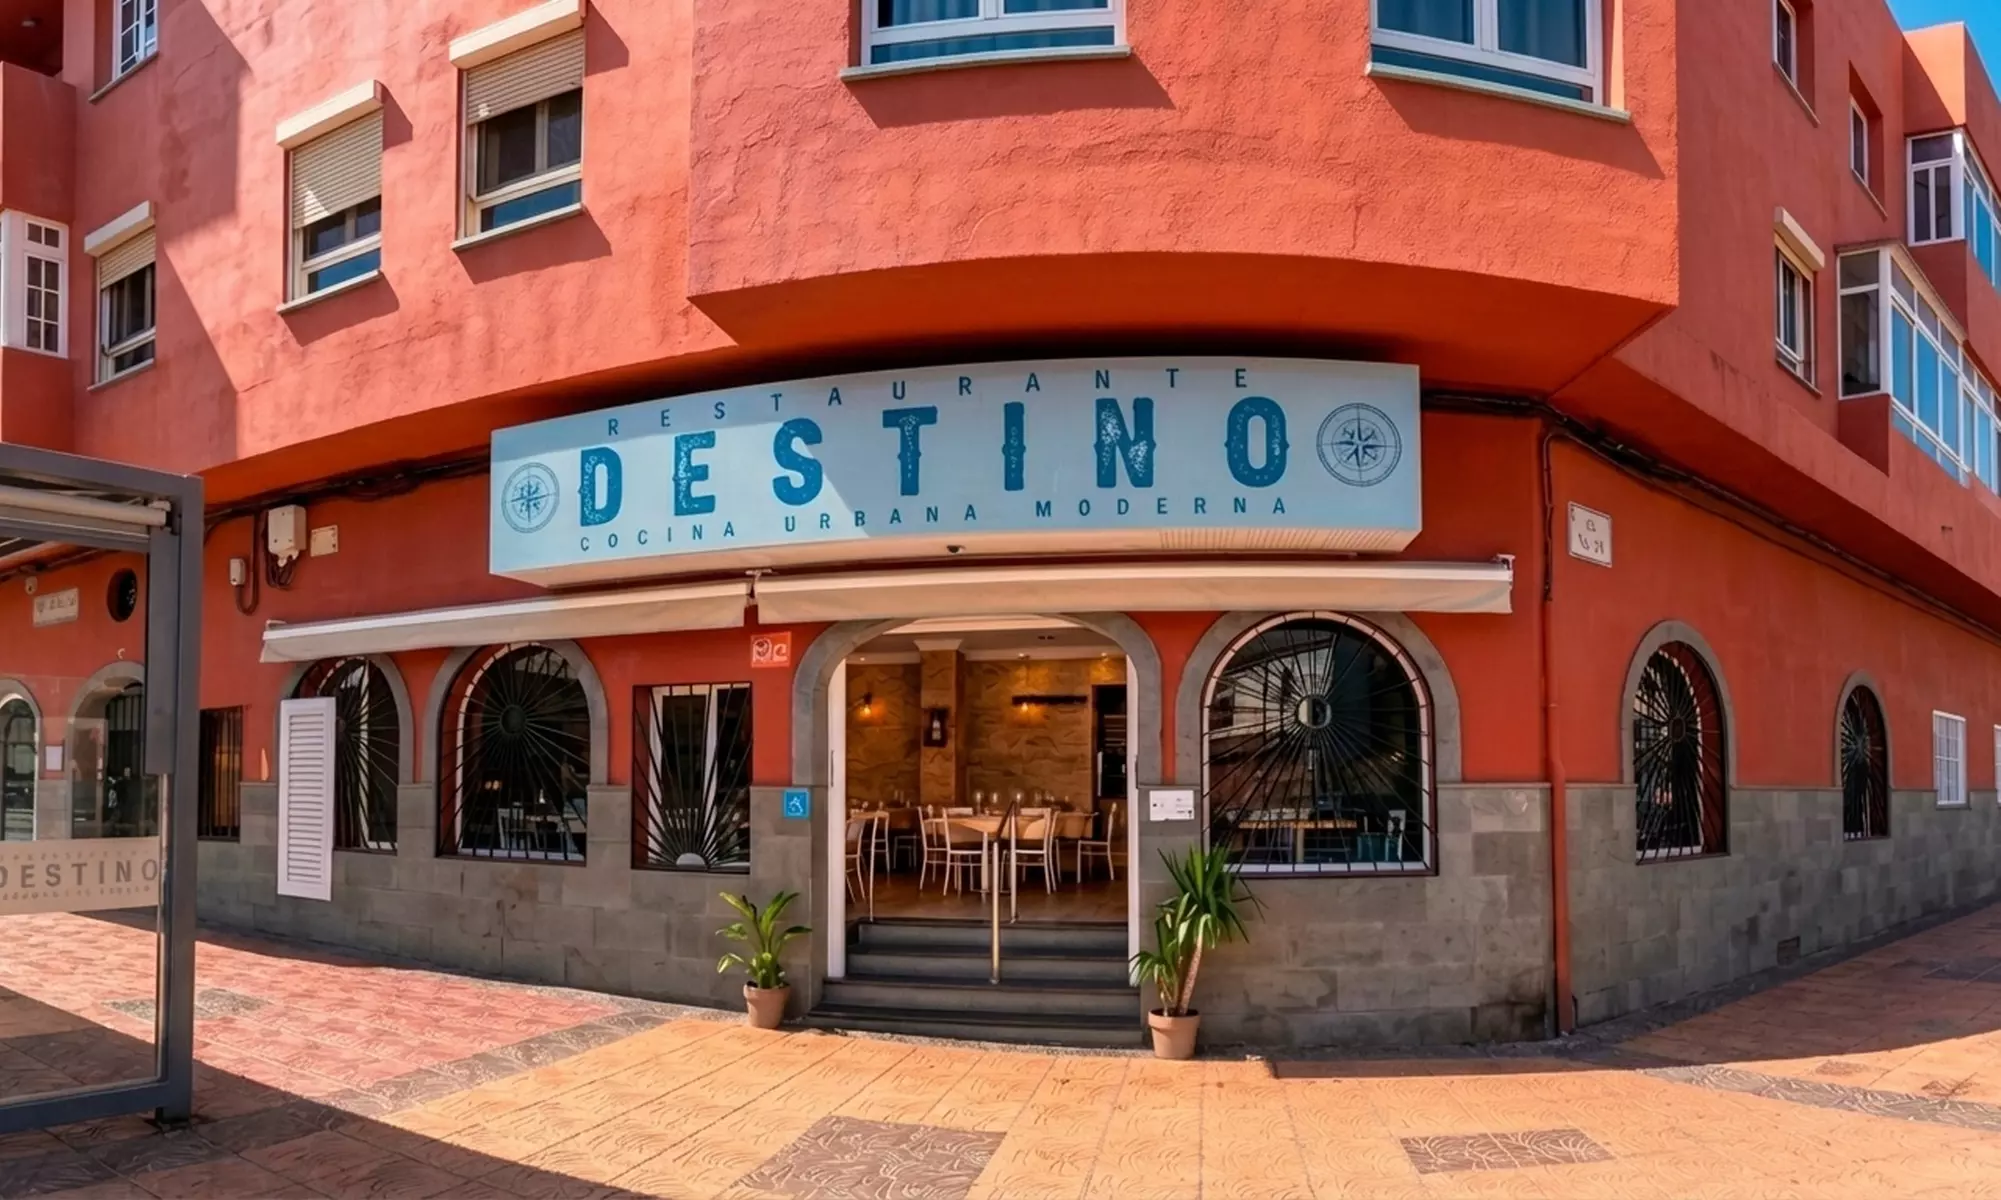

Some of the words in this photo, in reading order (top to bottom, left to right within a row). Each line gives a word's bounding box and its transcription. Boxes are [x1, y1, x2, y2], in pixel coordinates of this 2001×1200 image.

[608, 368, 1247, 436] RESTAURANTE
[577, 396, 1289, 528] DESTINO
[580, 521, 735, 552] COCINA
[785, 504, 977, 532] URBANA
[1035, 497, 1287, 518] MODERNA
